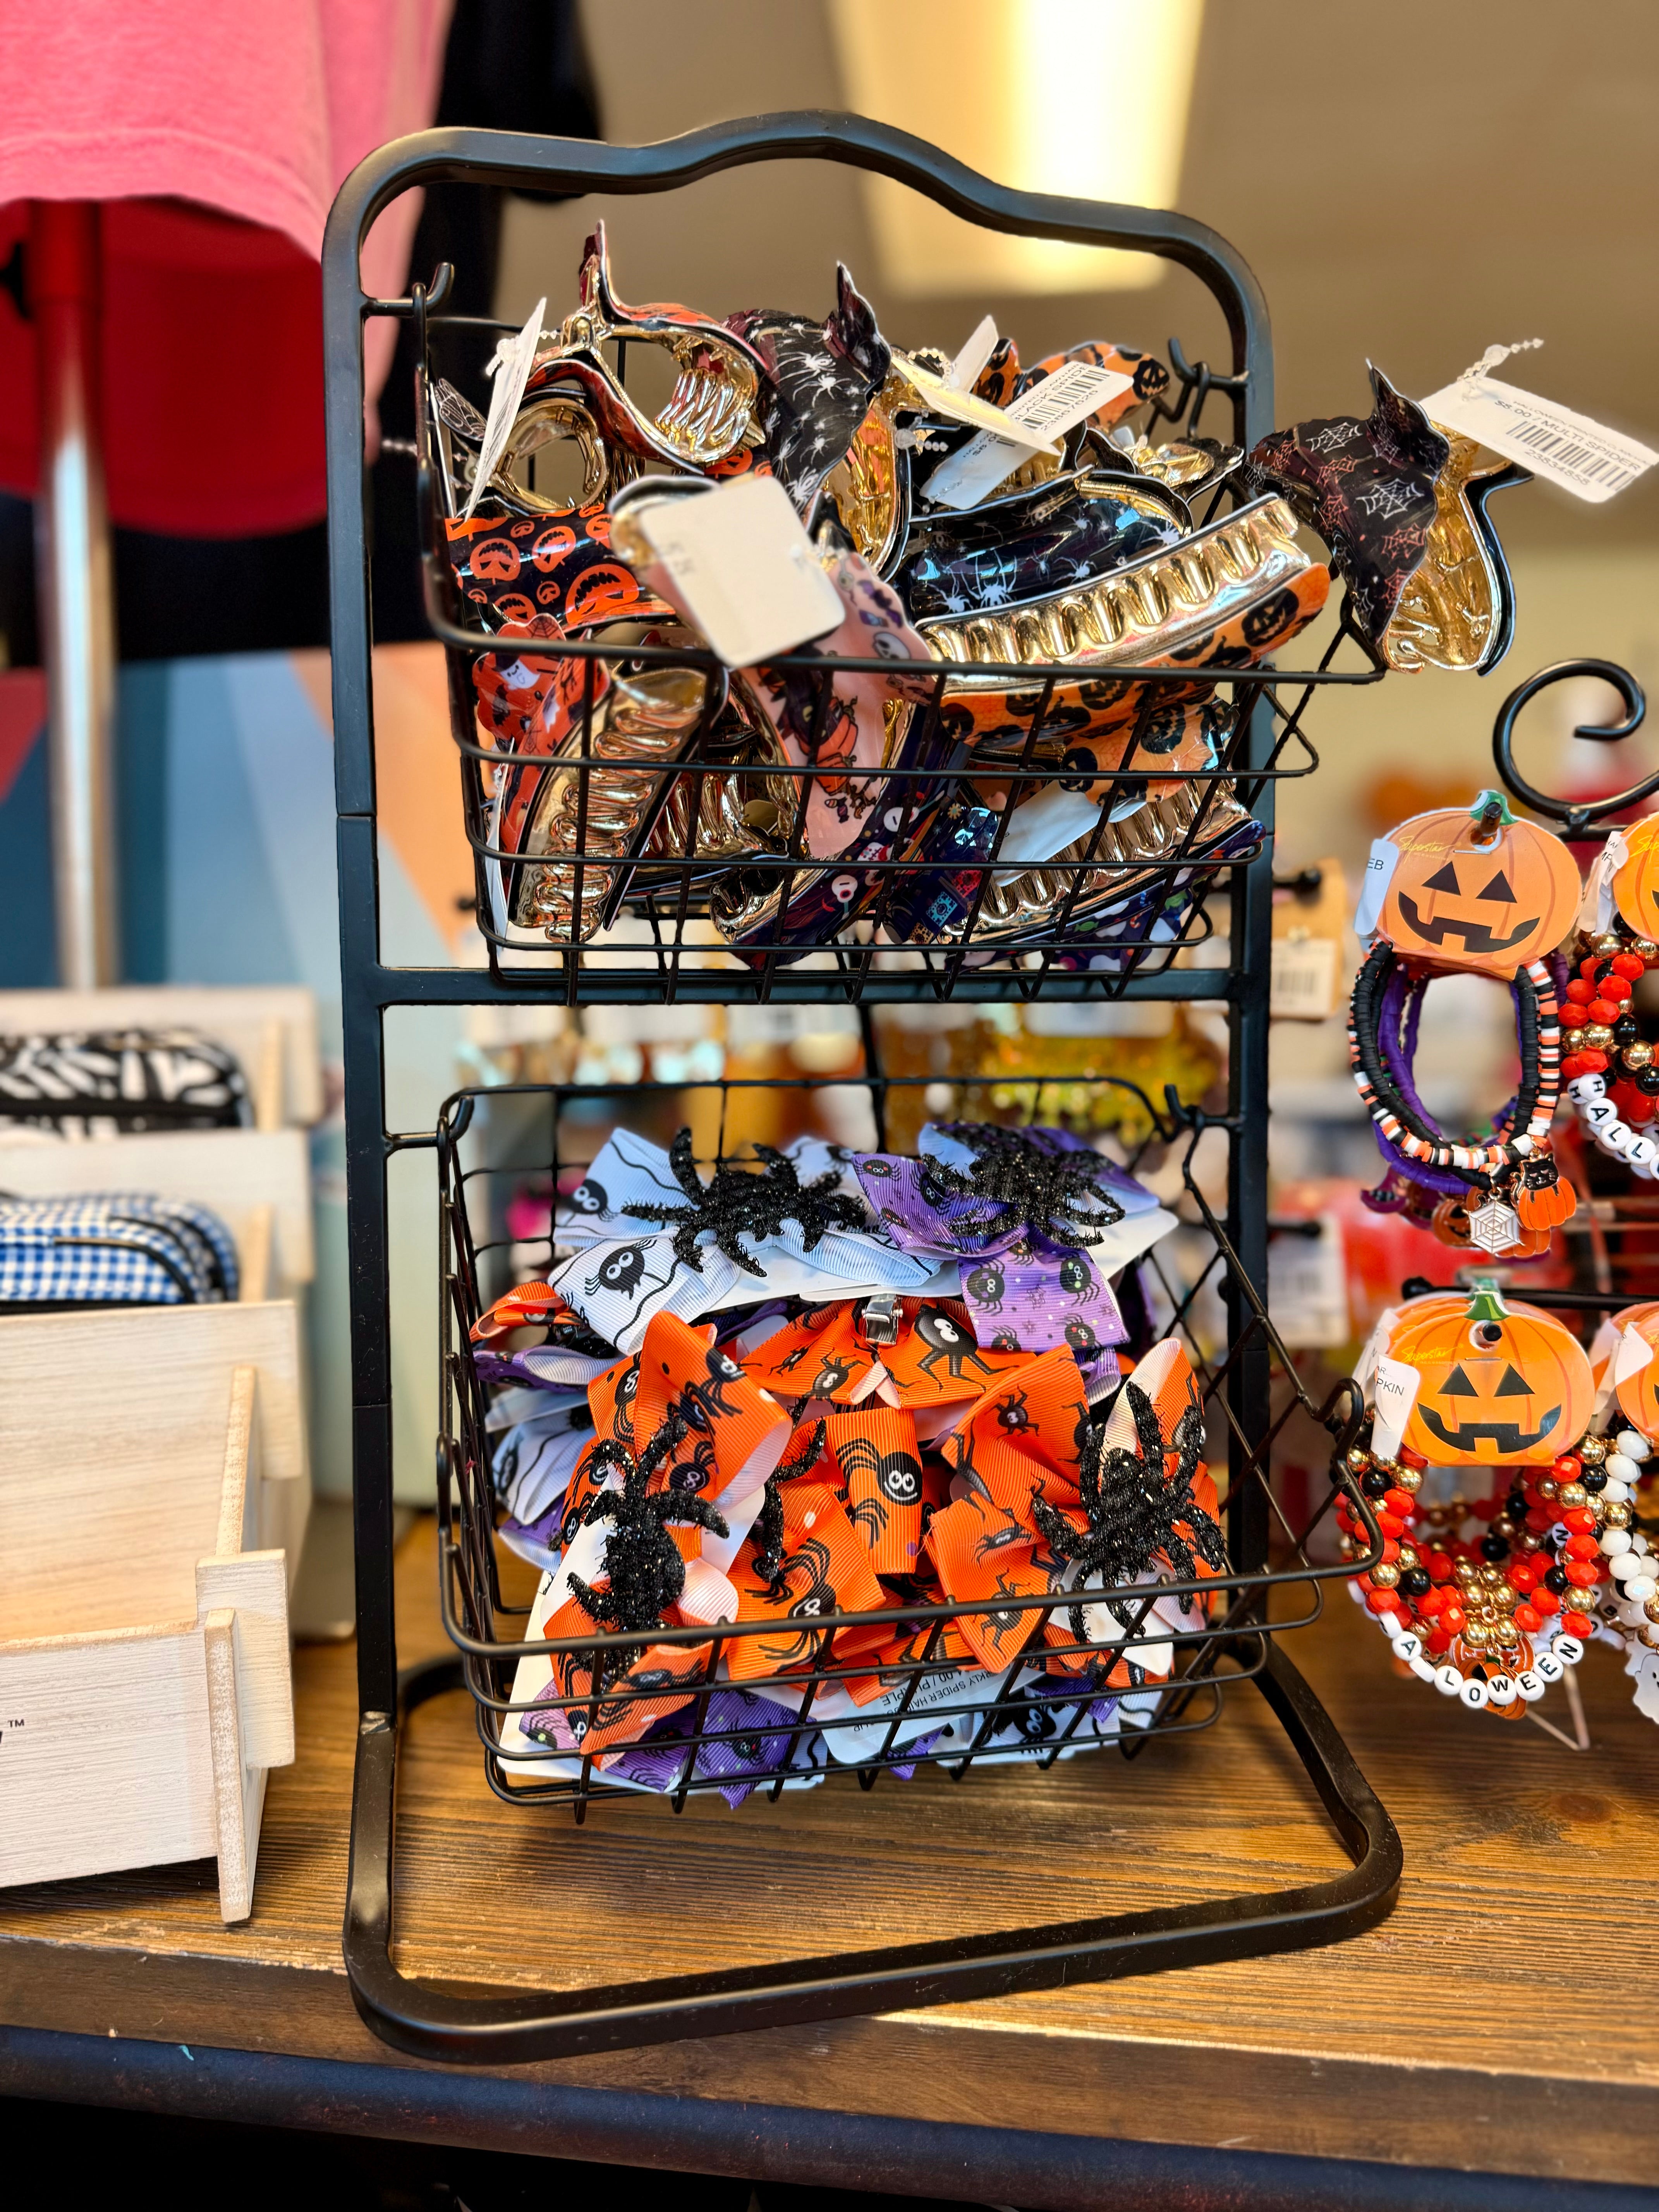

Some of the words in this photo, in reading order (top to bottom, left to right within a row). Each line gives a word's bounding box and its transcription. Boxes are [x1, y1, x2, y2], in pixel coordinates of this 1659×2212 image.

[1494, 400, 1532, 418] $8.00
[1540, 420, 1584, 442] MULTI
[1585, 441, 1641, 471] SPIDER
[1524, 448, 1590, 485] 23834858
[1399, 836, 1455, 864] Superstar
[1401, 1345, 1458, 1367] Superstar
[928, 1681, 966, 1702] SPIDER
